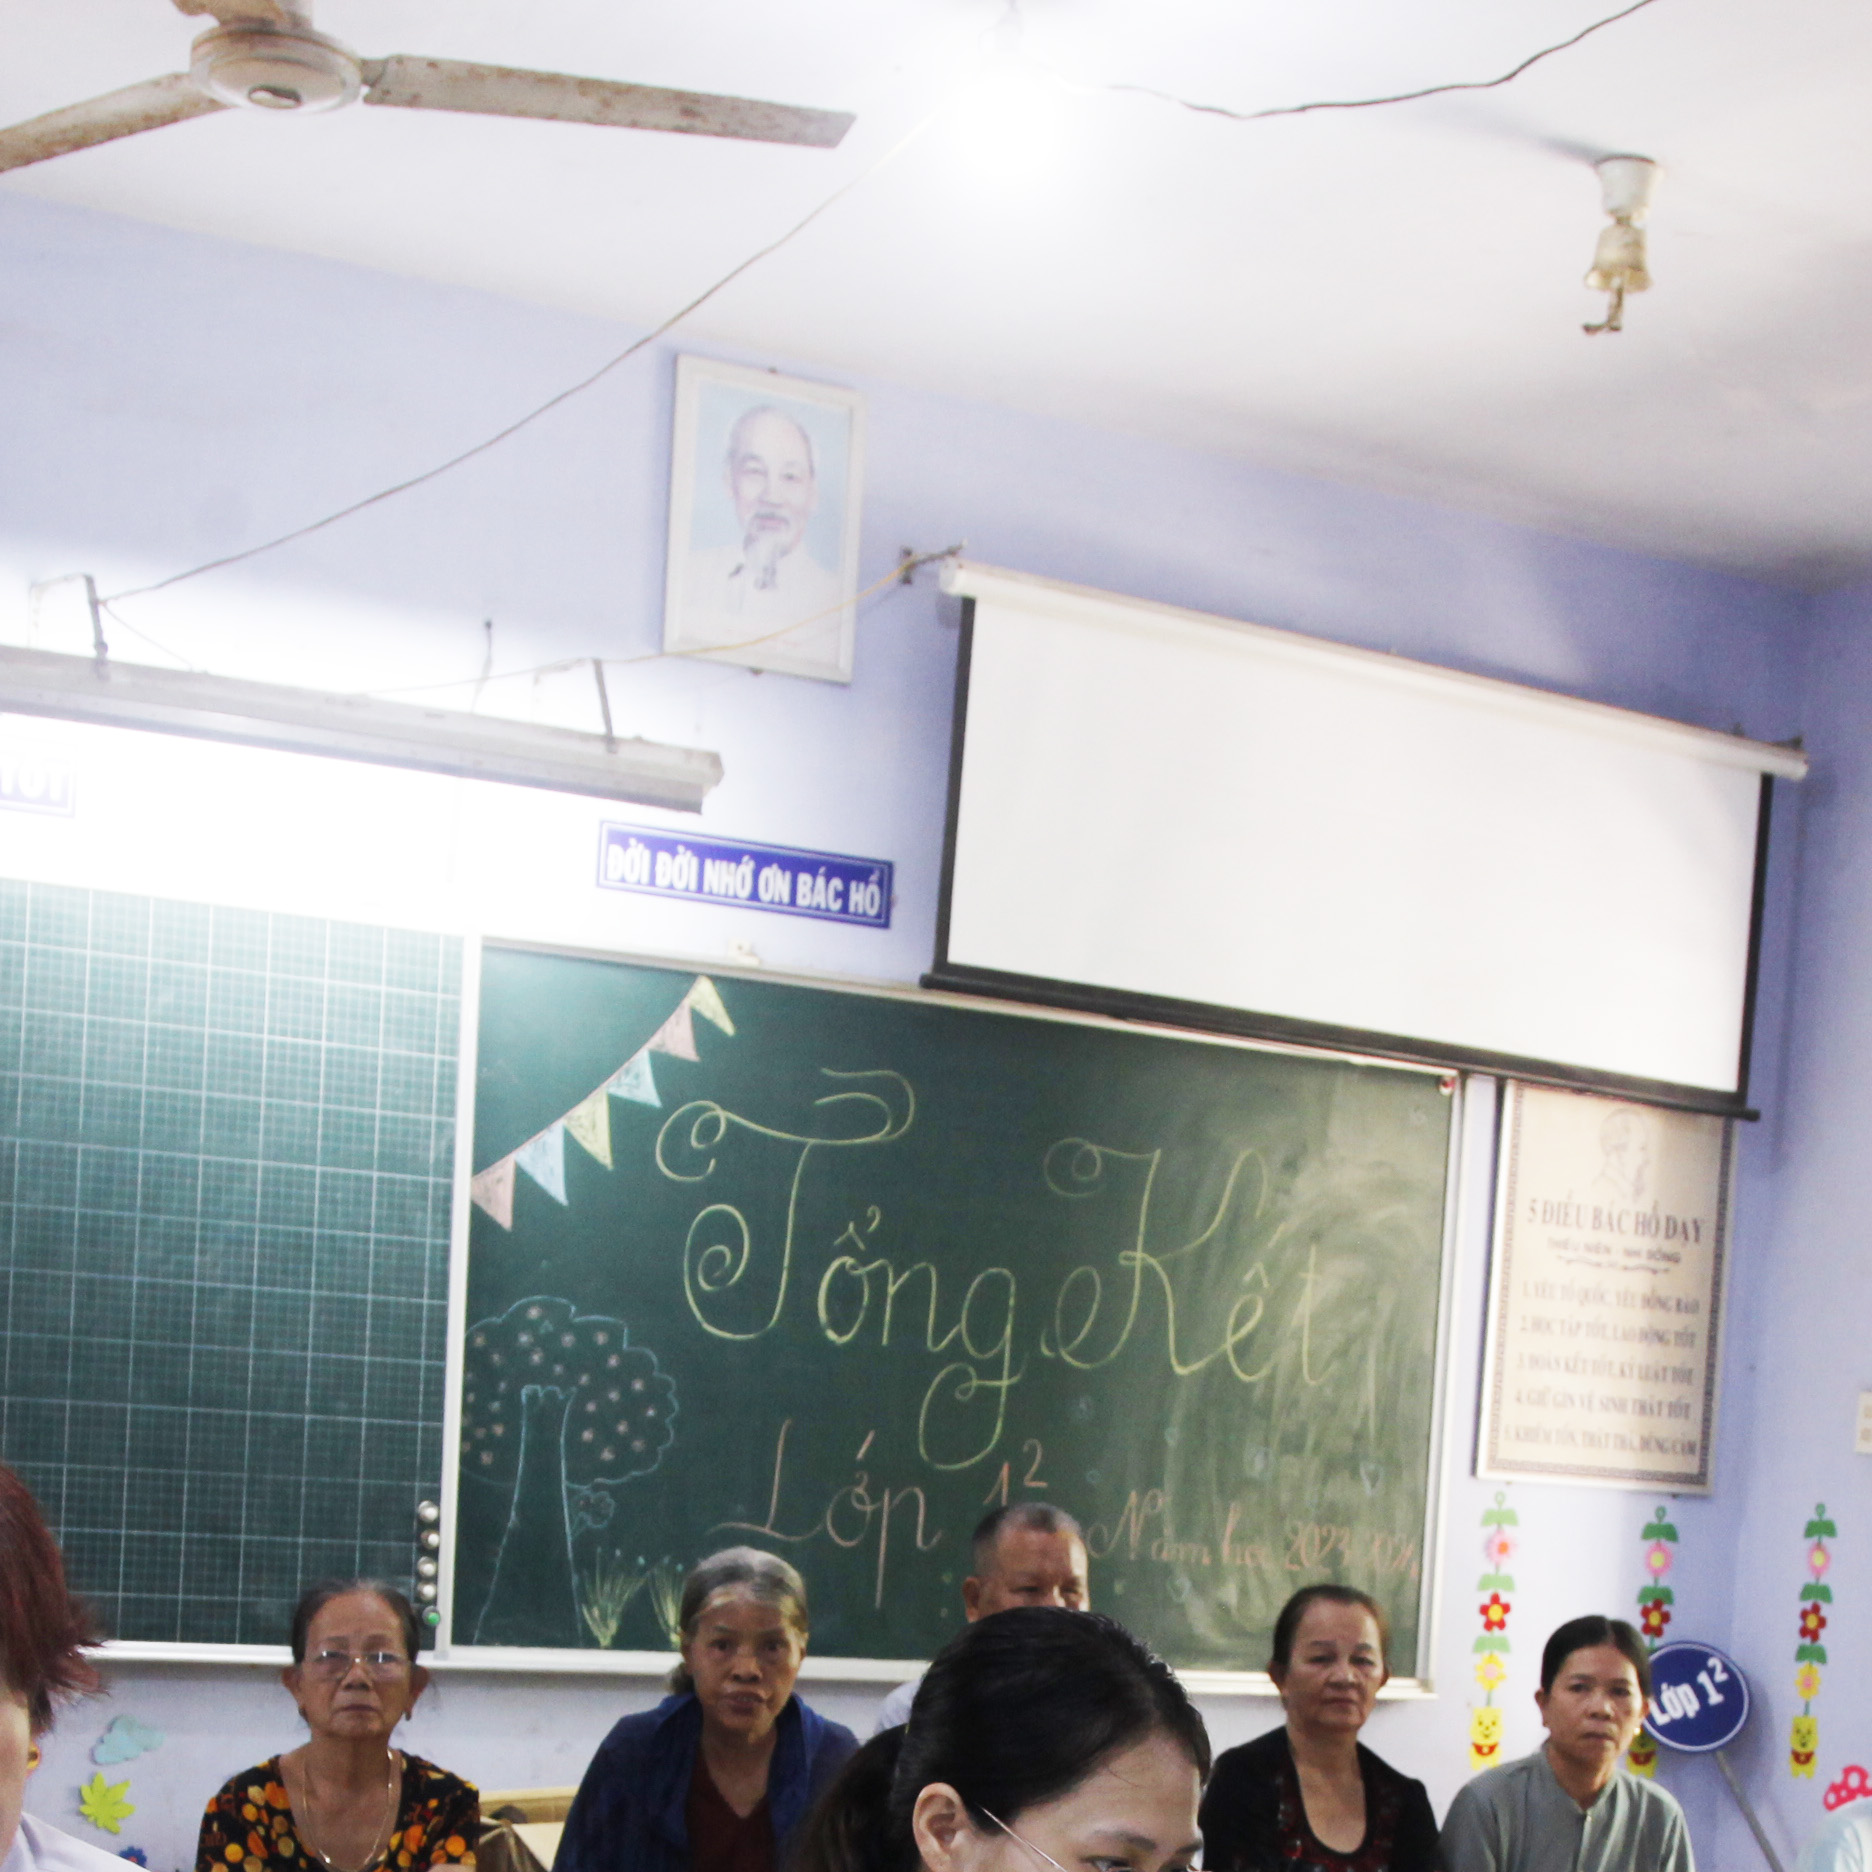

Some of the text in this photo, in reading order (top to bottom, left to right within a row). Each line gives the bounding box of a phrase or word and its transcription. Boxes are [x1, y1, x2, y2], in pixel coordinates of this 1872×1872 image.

[703, 855, 755, 899] NHỚ
[758, 863, 790, 904] ƠN
[797, 866, 844, 911] BÁC
[1665, 1218, 1705, 1246] DẠY
[656, 1069, 1339, 1470] Tổng Kết
[706, 1419, 943, 1609] Lớp
[1649, 1682, 1700, 1726] Lớp
